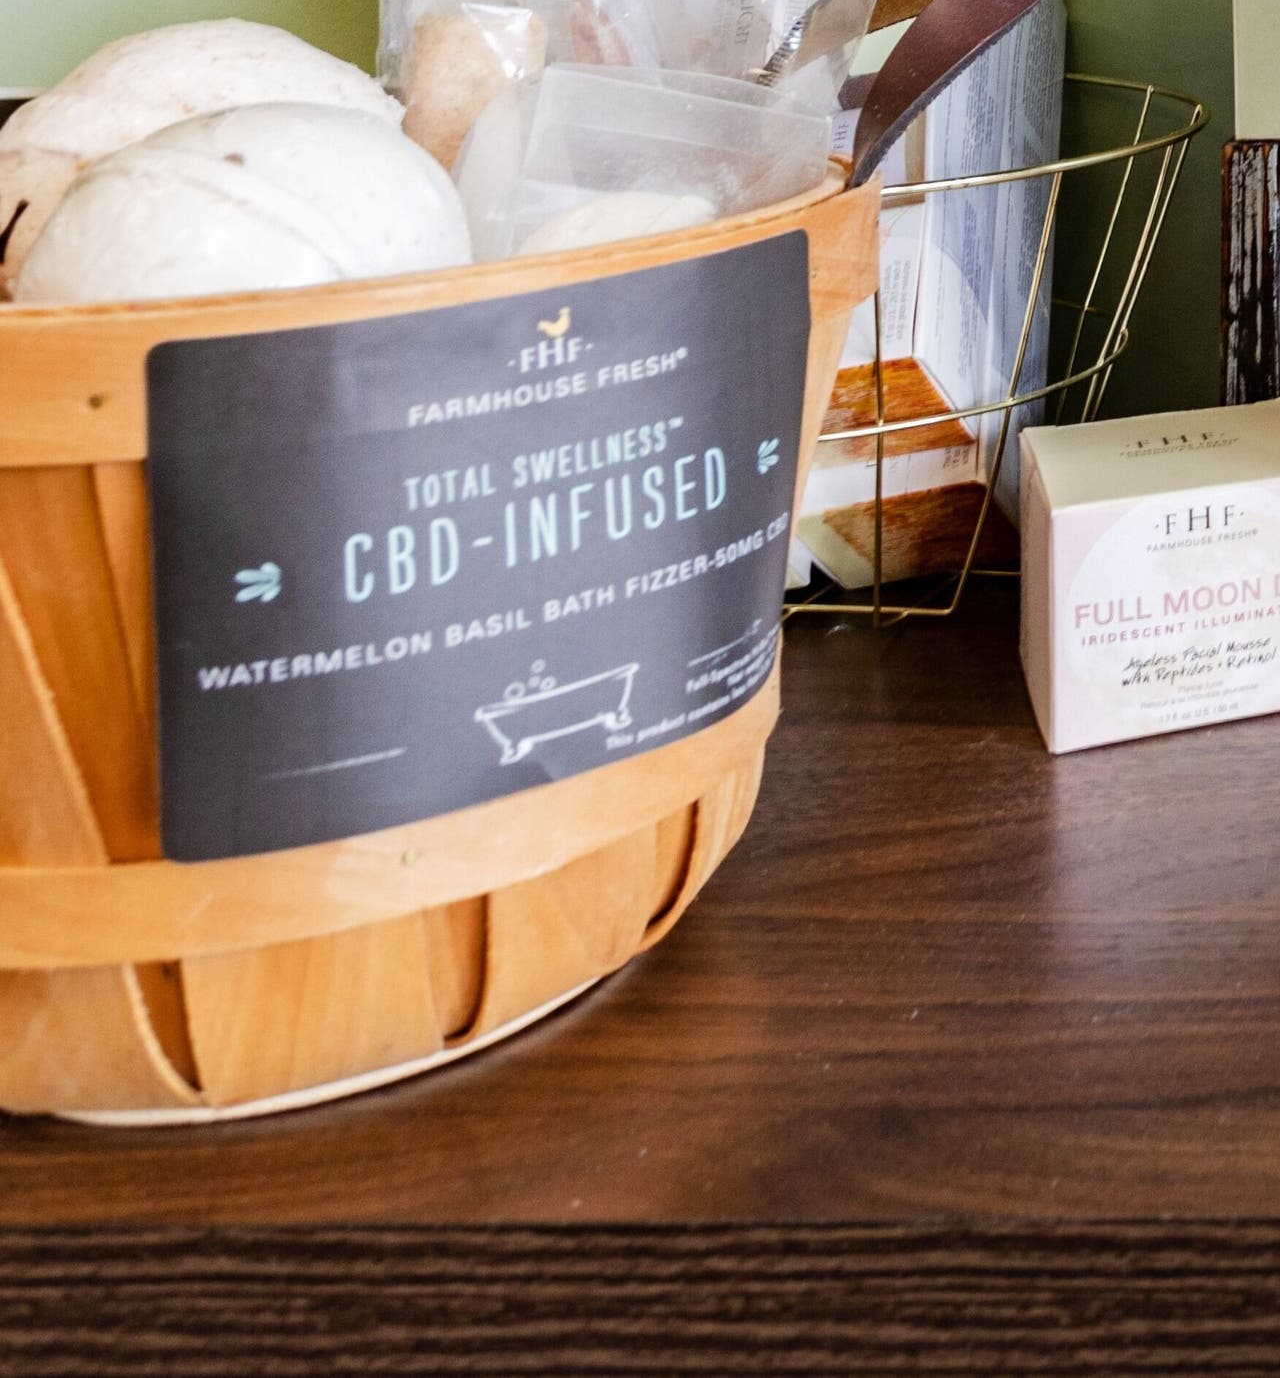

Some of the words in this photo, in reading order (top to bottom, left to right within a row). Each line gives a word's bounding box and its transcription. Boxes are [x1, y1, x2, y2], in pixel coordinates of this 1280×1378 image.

[407, 372, 587, 428] FARMHOUSE
[404, 461, 497, 512] TOTAL
[342, 445, 728, 604] CBD-INFUSED
[1146, 536, 1213, 553] FARMHOUSE
[1074, 596, 1152, 629] FULL
[1163, 577, 1262, 616] MOON
[198, 631, 433, 691] WATERMELON
[445, 608, 532, 649] BASIL
[543, 585, 615, 623] BATH
[1081, 622, 1186, 647] IRIDESCENT
[1123, 652, 1177, 671] Ageless
[1182, 642, 1223, 661] Facial
[1226, 637, 1272, 652] Mousse
[1121, 670, 1150, 687] with
[1155, 664, 1214, 685] Peptides
[1227, 647, 1277, 668] Retinol
